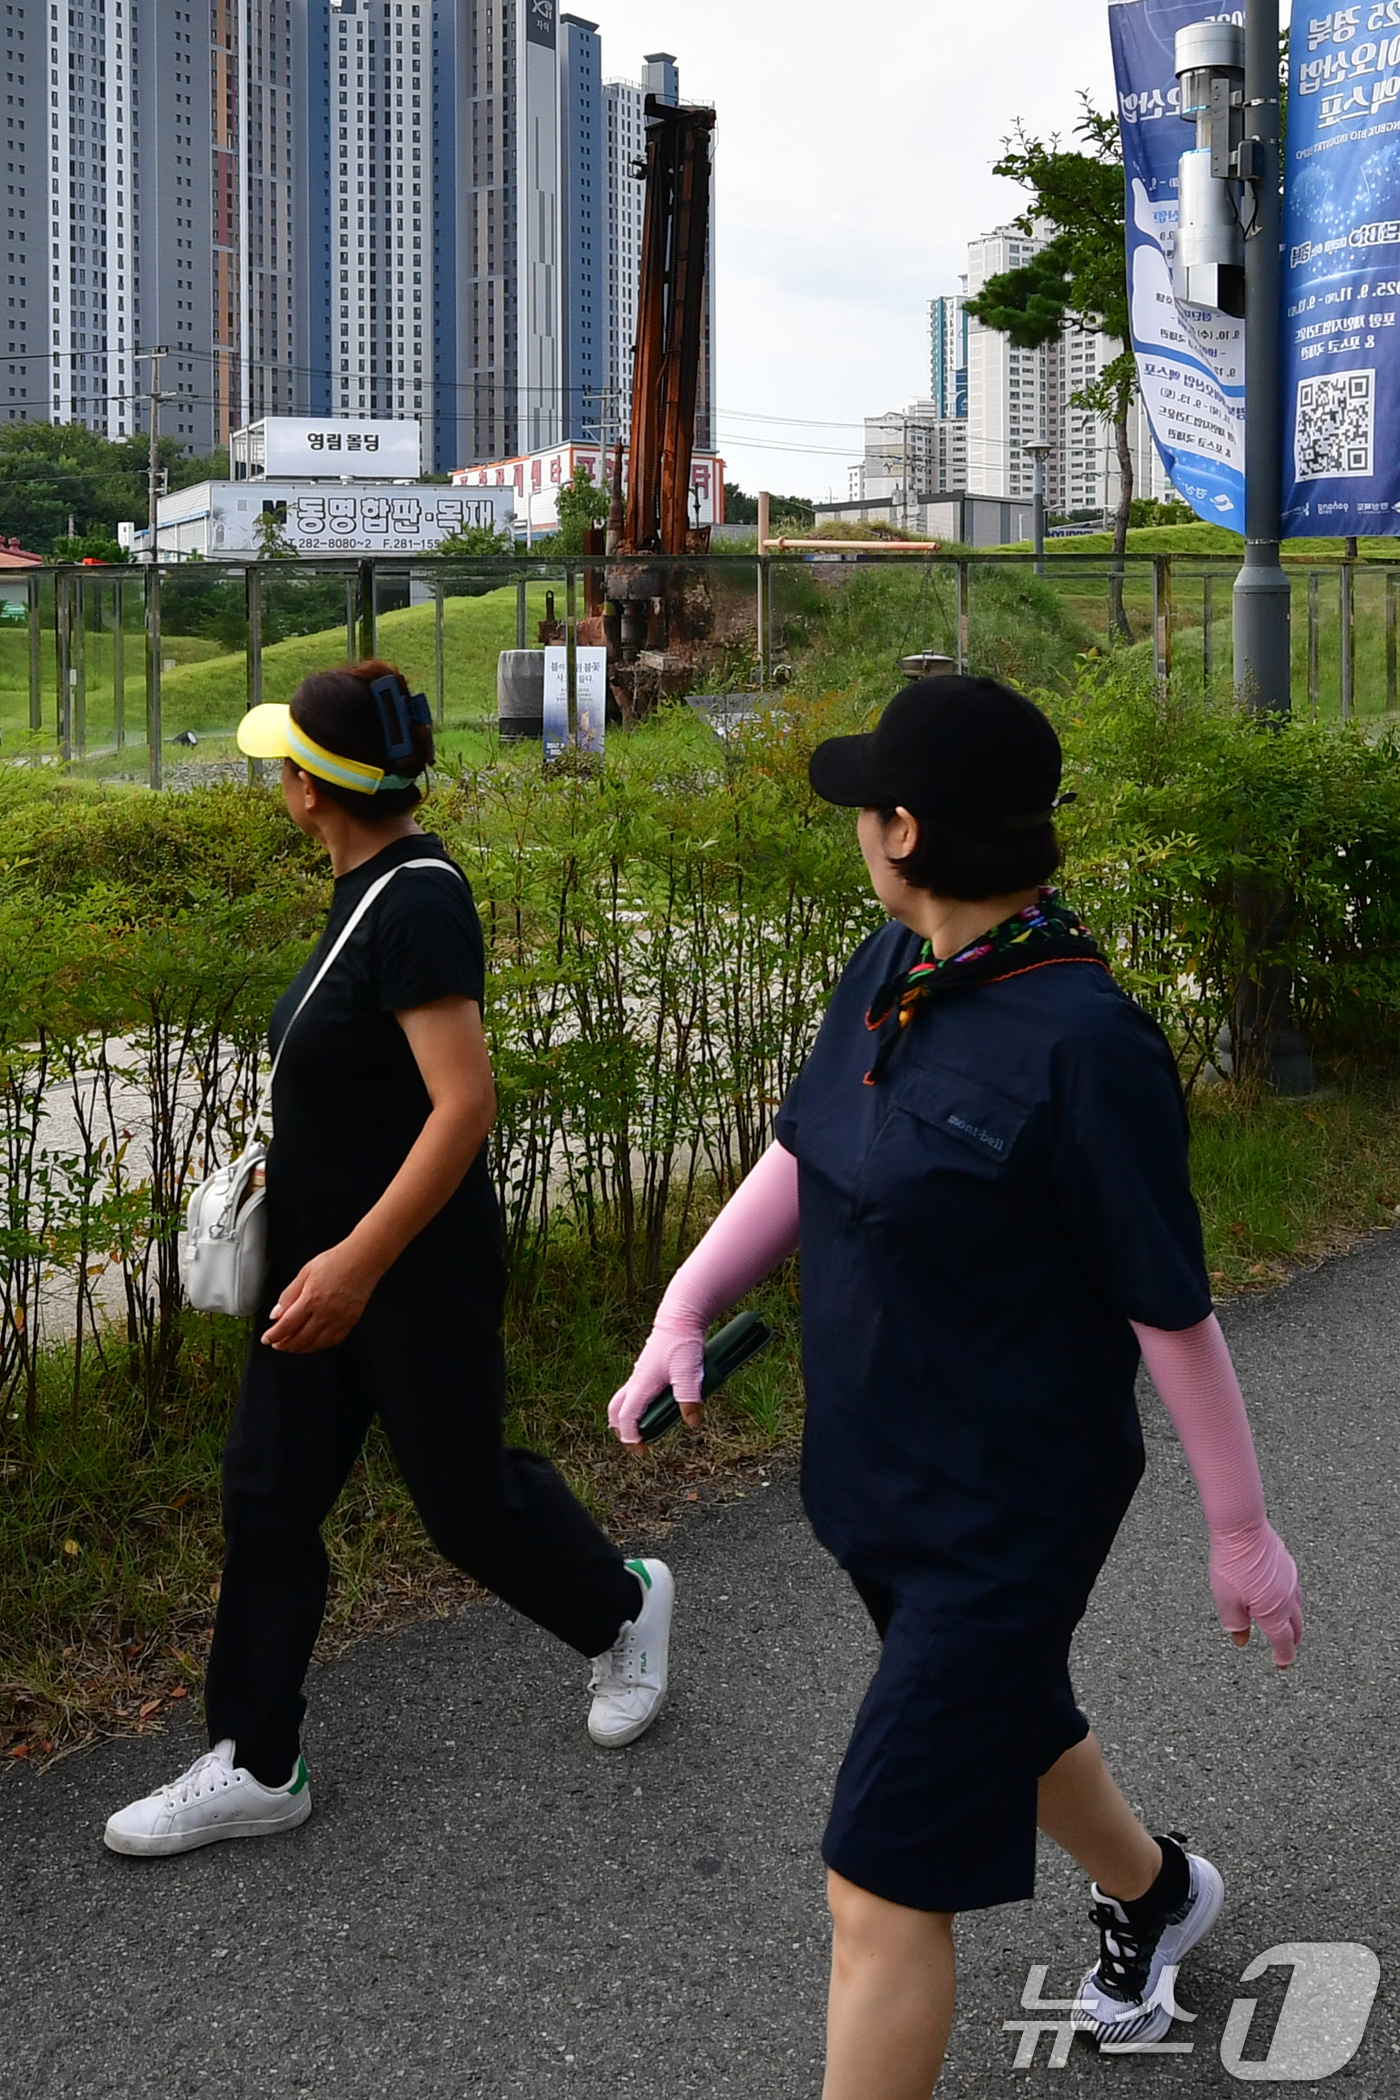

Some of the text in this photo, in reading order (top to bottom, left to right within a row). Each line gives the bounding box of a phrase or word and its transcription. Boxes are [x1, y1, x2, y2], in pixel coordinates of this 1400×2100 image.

[536, 19, 550, 33] 자이
[307, 432, 379, 452] 영림 몰딩
[383, 538, 440, 552] F.281-155
